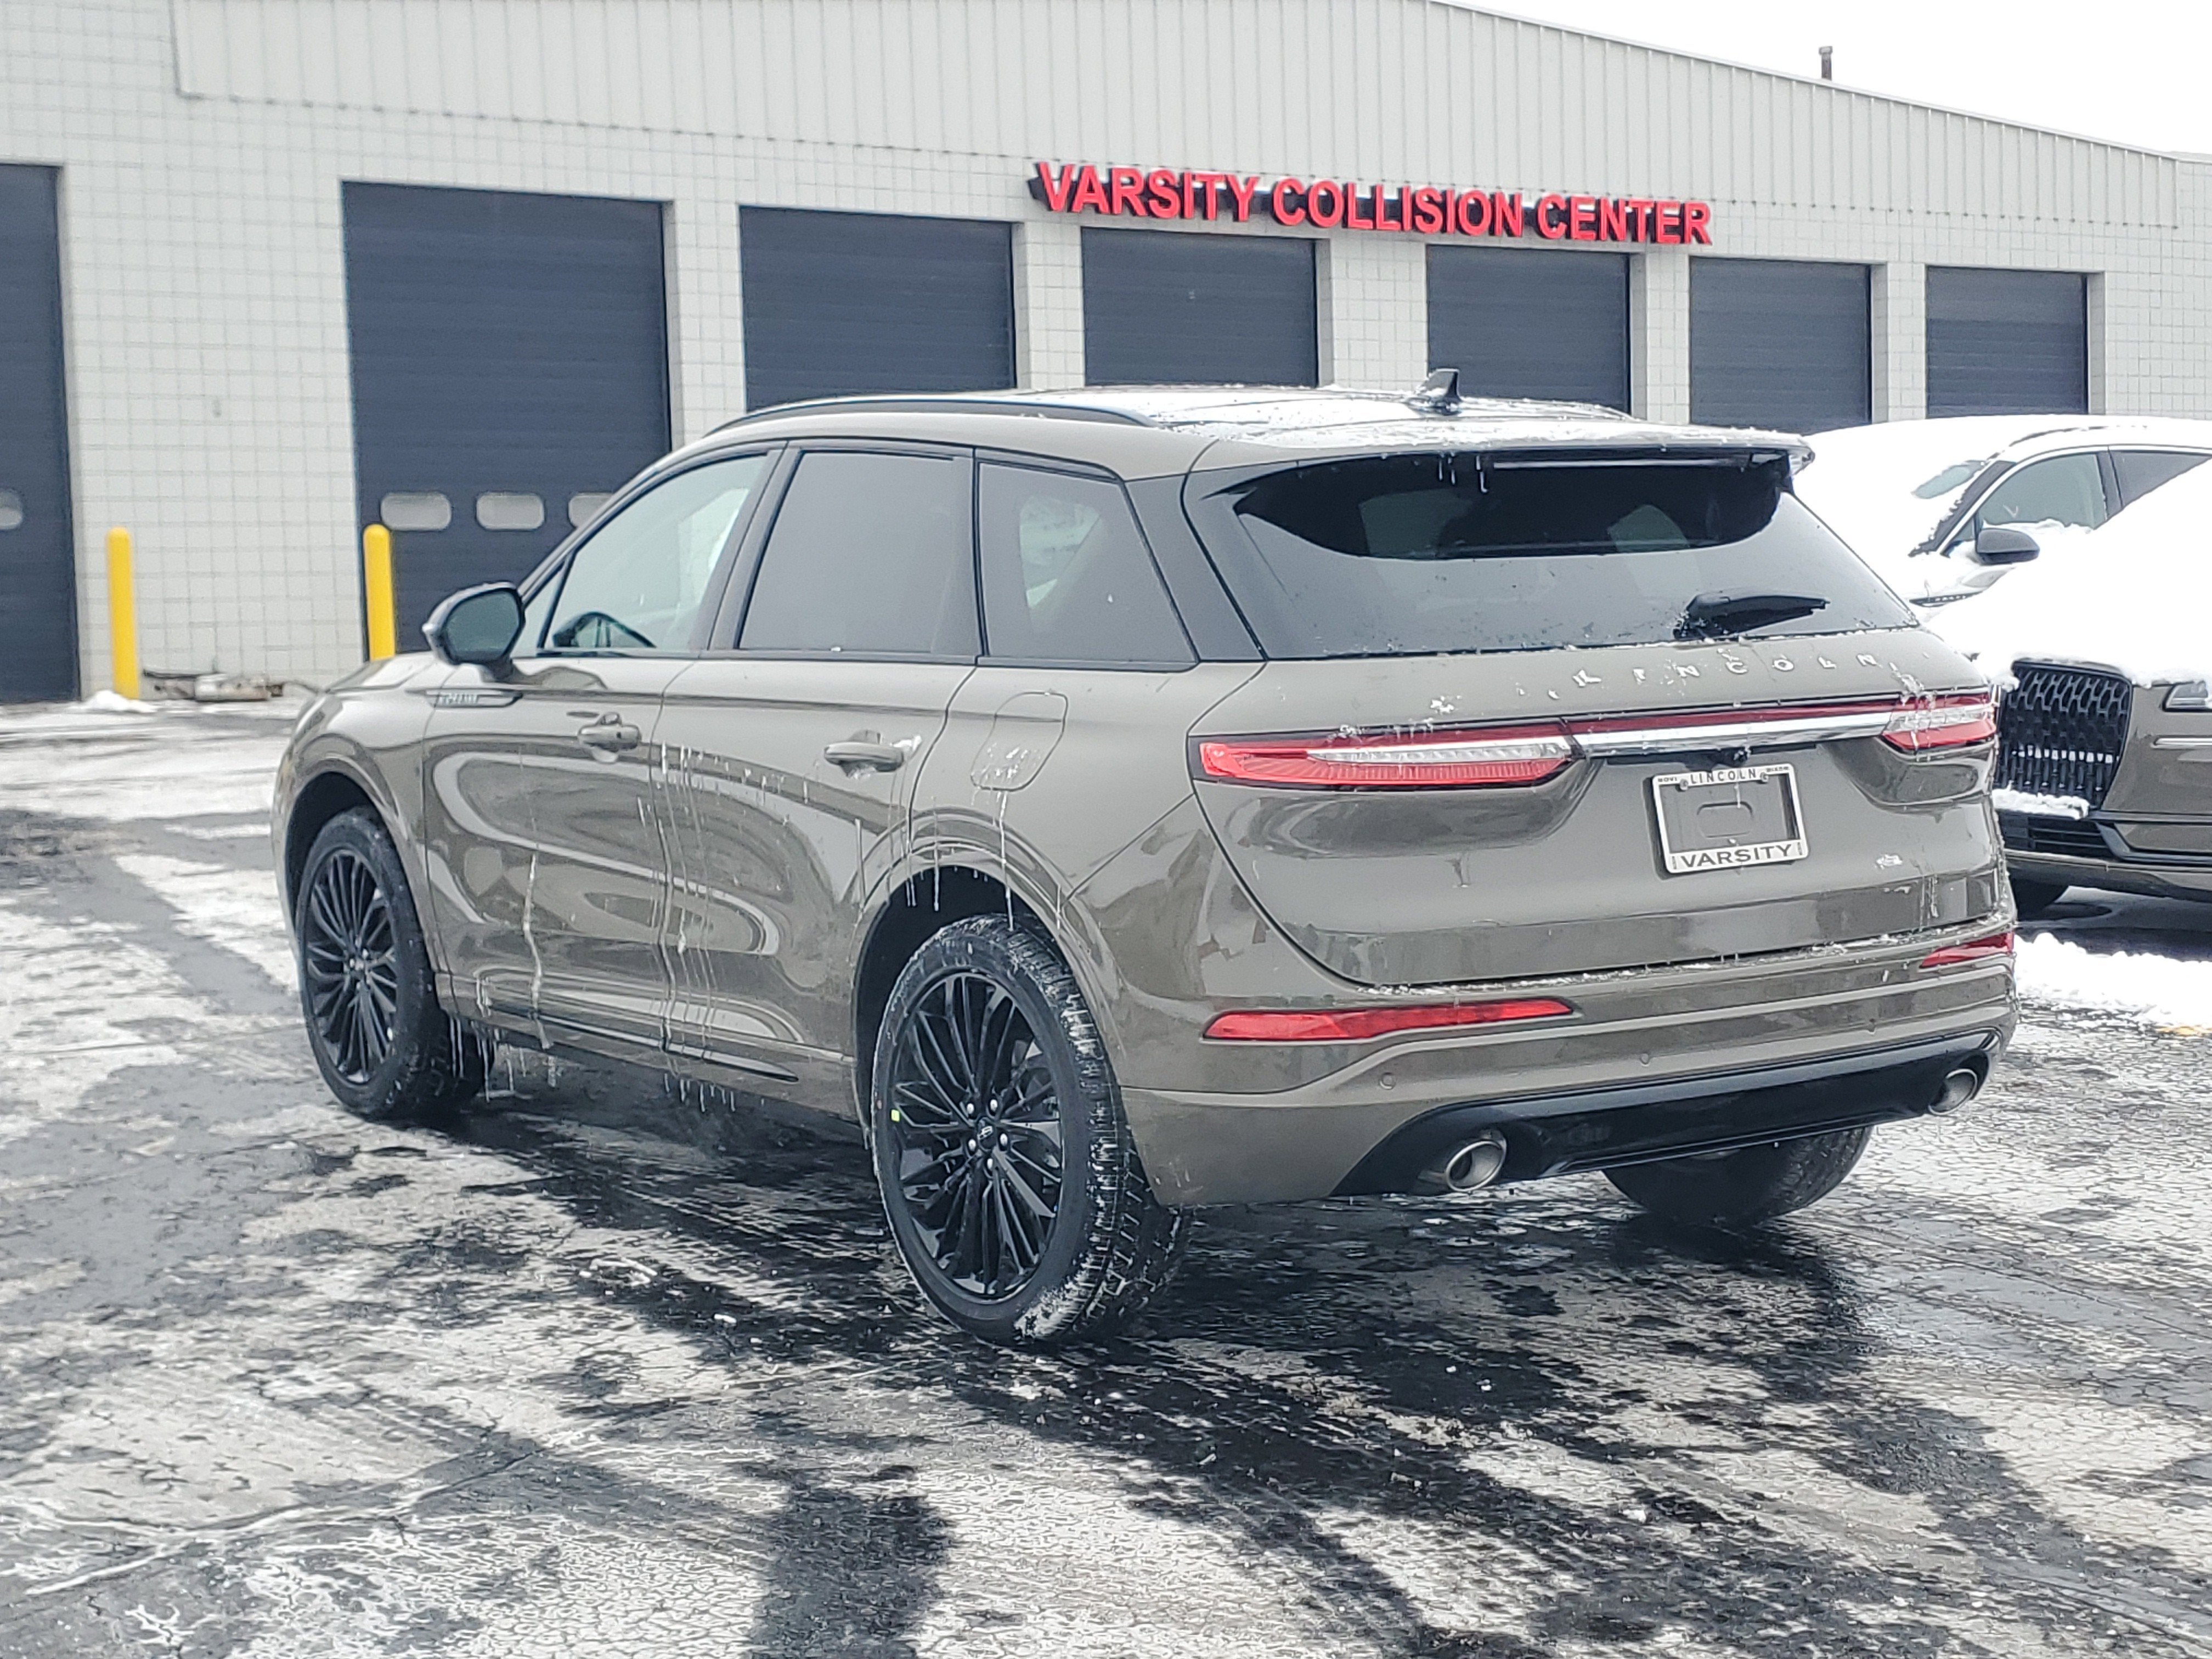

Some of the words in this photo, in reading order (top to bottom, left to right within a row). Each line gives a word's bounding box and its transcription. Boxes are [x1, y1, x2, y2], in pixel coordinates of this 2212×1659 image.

[1038, 161, 1260, 222] VARSITY
[1273, 177, 1523, 238] COLLISION
[1537, 193, 1713, 246] CENTER
[1690, 768, 1757, 785] LINCOLN
[1680, 844, 1792, 868] VARSITY
